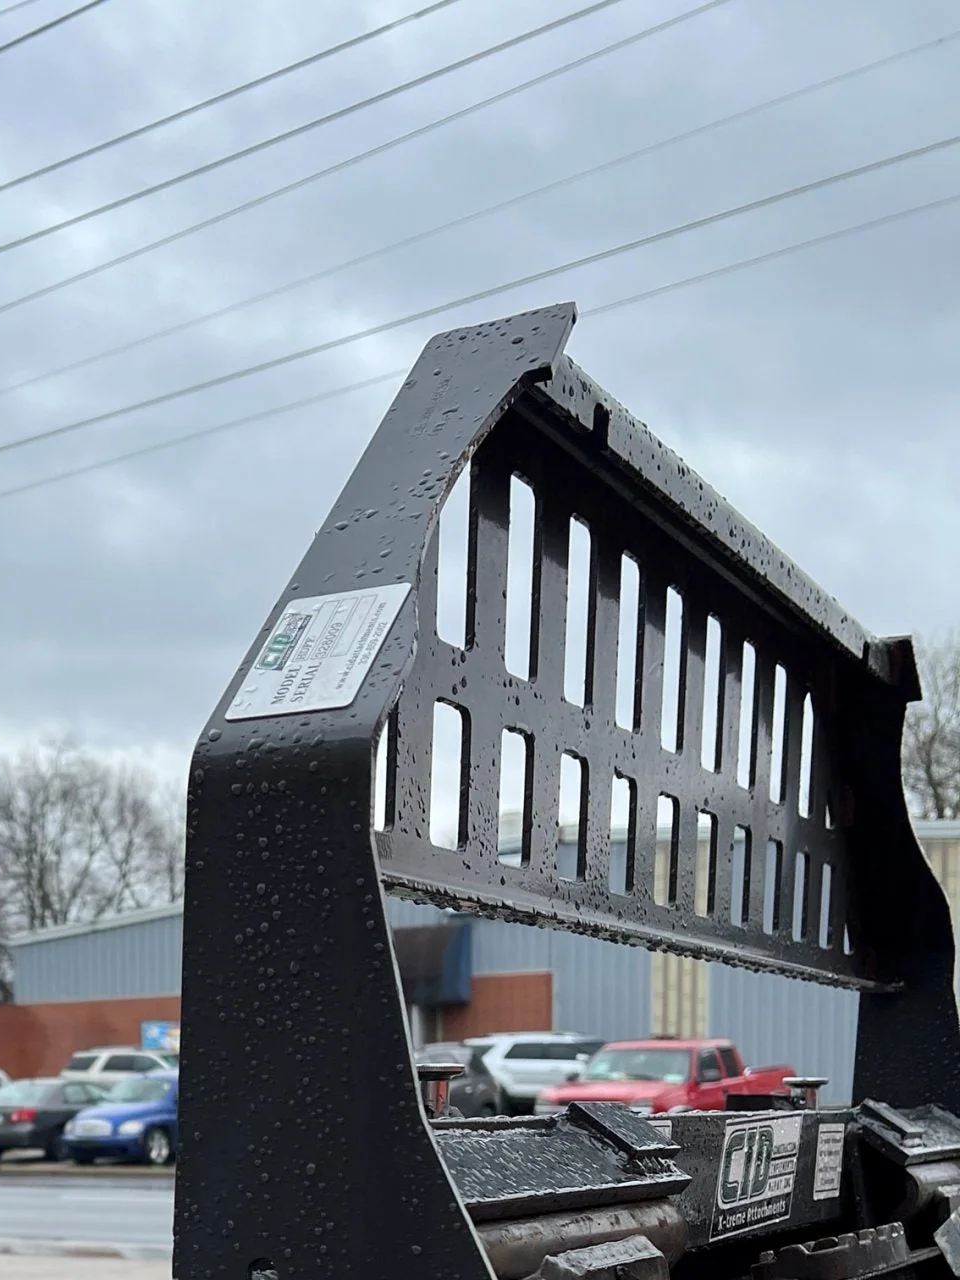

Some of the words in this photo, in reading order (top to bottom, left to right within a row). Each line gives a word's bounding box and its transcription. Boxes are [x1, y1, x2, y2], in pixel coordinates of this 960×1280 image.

[271, 665, 302, 705] MODEL
[290, 662, 322, 703] SERIAL
[721, 1126, 773, 1204] CID
[717, 1213, 746, 1230] X-treme
[747, 1200, 786, 1221] Attachments
